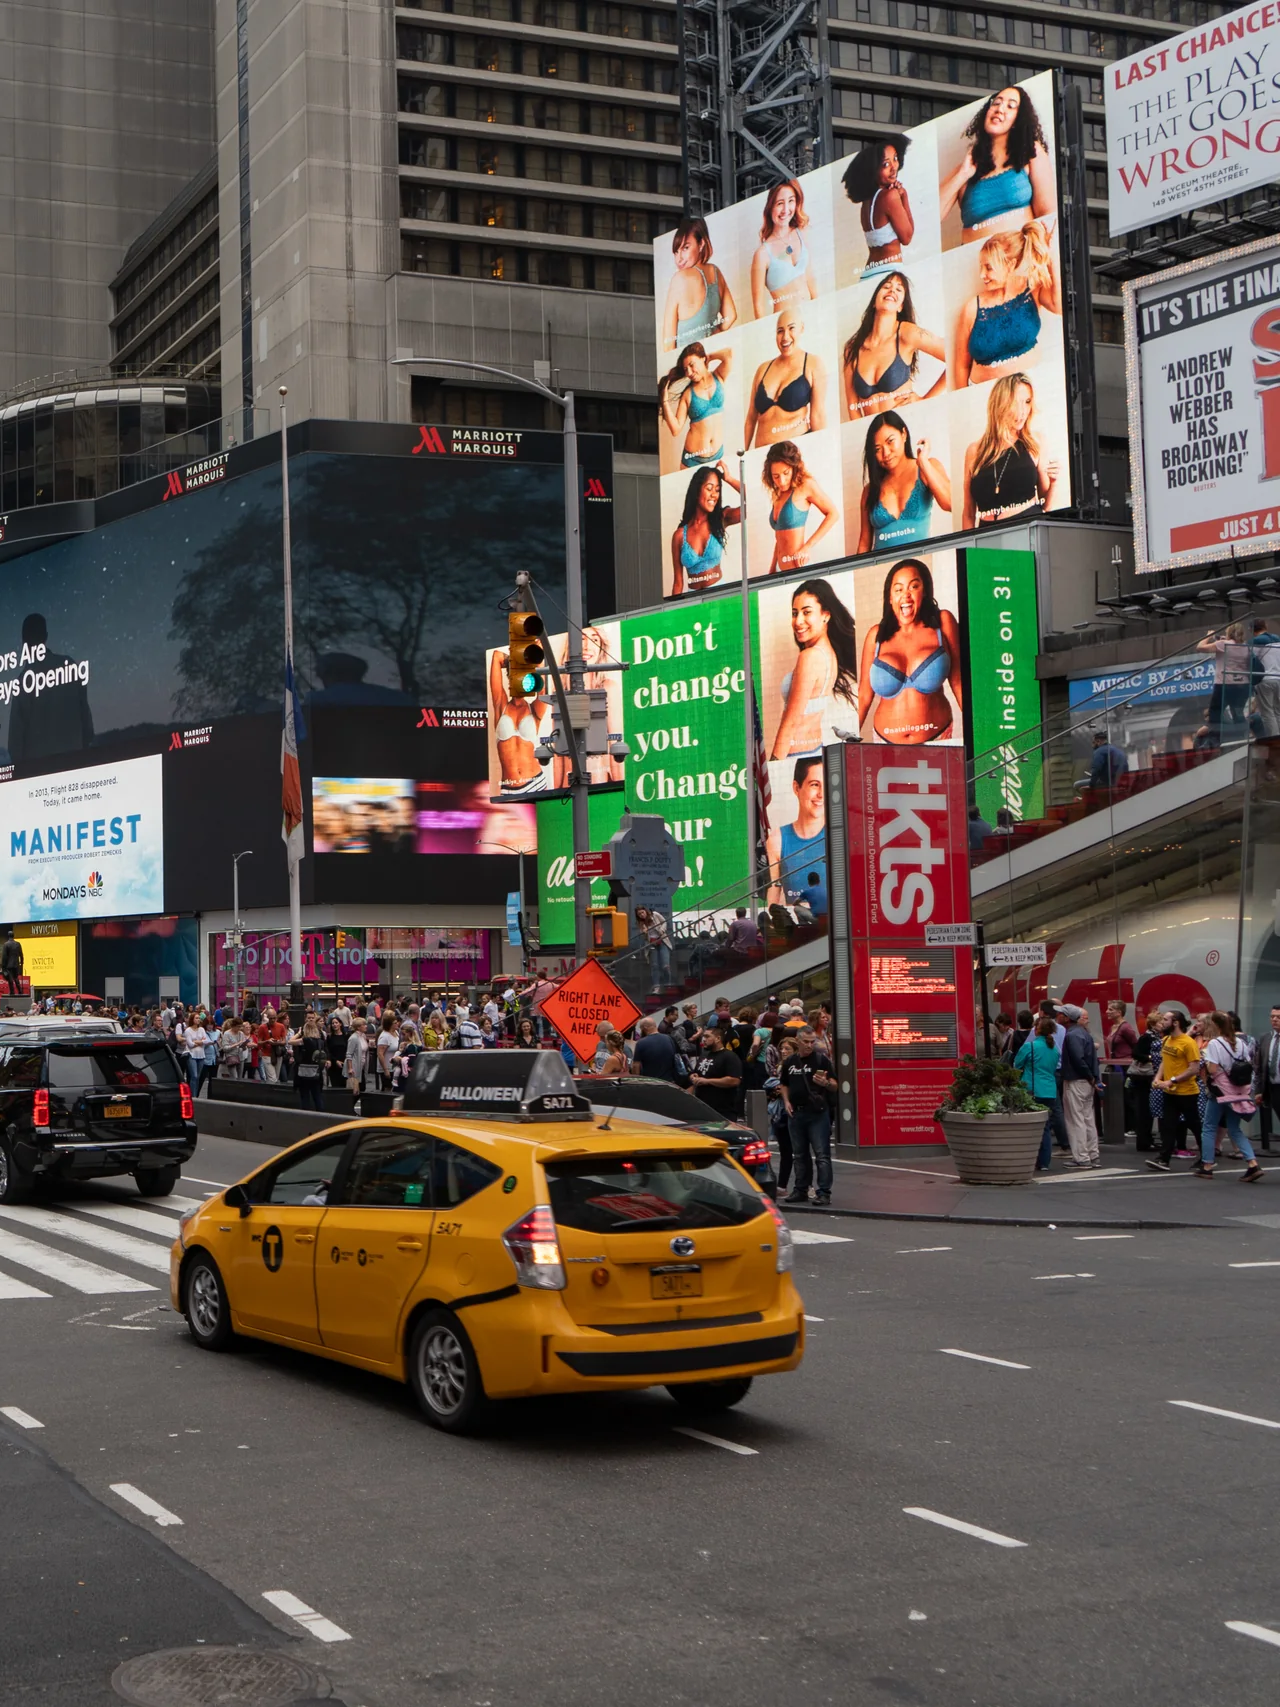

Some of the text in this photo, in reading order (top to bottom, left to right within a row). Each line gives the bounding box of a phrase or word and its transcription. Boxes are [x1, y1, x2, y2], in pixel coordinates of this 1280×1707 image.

[1115, 49, 1170, 90] LAST
[1129, 43, 1270, 123] THE PLAY
[1117, 114, 1182, 156] THAT
[1117, 118, 1280, 195] WRONG
[1152, 168, 1250, 208] 149 WEST 45TH STREET
[1142, 298, 1183, 336] IT'S
[1187, 280, 1229, 321] THE
[1176, 370, 1225, 401] LLOYD
[1169, 391, 1233, 424] WEBBER
[453, 430, 522, 443] MARRIOTT
[1186, 416, 1219, 442] HAS
[453, 442, 516, 456] MARQUIS
[1161, 429, 1249, 470] BROADWAY
[186, 453, 229, 477] MARRIOTT
[186, 466, 225, 489] MARQUIS
[1194, 482, 1216, 492] REUTERS
[1219, 512, 1273, 541] JUST 4
[20, 642, 46, 667] Are
[632, 622, 718, 666] Don't
[993, 576, 1016, 730] inside on 3!
[22, 659, 89, 697] Opening
[633, 667, 745, 710] change
[1092, 671, 1169, 693] MUSIC BY
[443, 710, 489, 719] MARRIOTT
[443, 719, 486, 728] MARQUIS
[184, 726, 213, 739] MARRIOTT
[184, 735, 211, 747] MARQUIS
[633, 726, 699, 762] you.
[35, 787, 50, 798] 2013,
[50, 784, 67, 796] Flight
[68, 783, 79, 792] 828
[80, 776, 118, 791] disappeared.
[636, 764, 748, 802] Change
[43, 792, 102, 808] Today, it came home.
[10, 813, 141, 857] MANIFEST
[877, 759, 947, 925] tkts
[84, 851, 100, 859] ROBERT
[869, 848, 877, 901] Development
[42, 885, 86, 901] MONDAYS
[88, 888, 103, 898] NBC
[31, 924, 58, 935] INVICTA
[991, 945, 1043, 955] PEDESTRIAN FLOW ZONE
[1014, 954, 1044, 963] KEEP MOVING
[558, 990, 622, 1008] RIGHT LANE
[568, 1006, 610, 1021] CLOSED
[440, 1086, 523, 1101] HALLOWEEN
[543, 1097, 574, 1109] 5A71
[900, 1126, 935, 1134] www.tdf.org
[436, 1221, 463, 1236] 5A71
